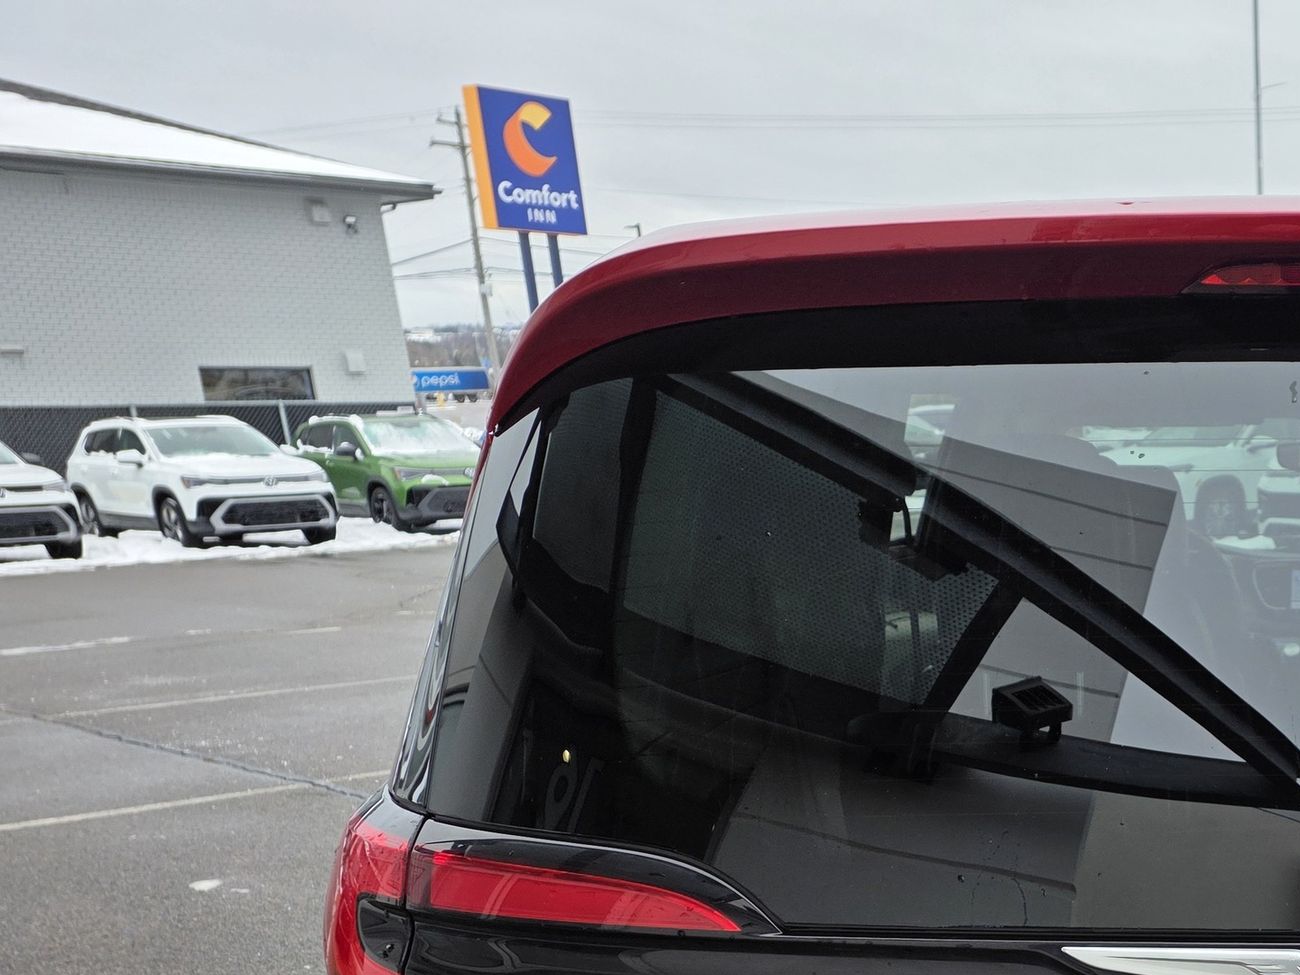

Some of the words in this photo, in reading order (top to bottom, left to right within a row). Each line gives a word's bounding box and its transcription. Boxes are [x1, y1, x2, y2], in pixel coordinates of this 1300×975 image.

[497, 180, 579, 209] Comfort
[526, 207, 557, 224] INN
[421, 373, 461, 389] pepsi
